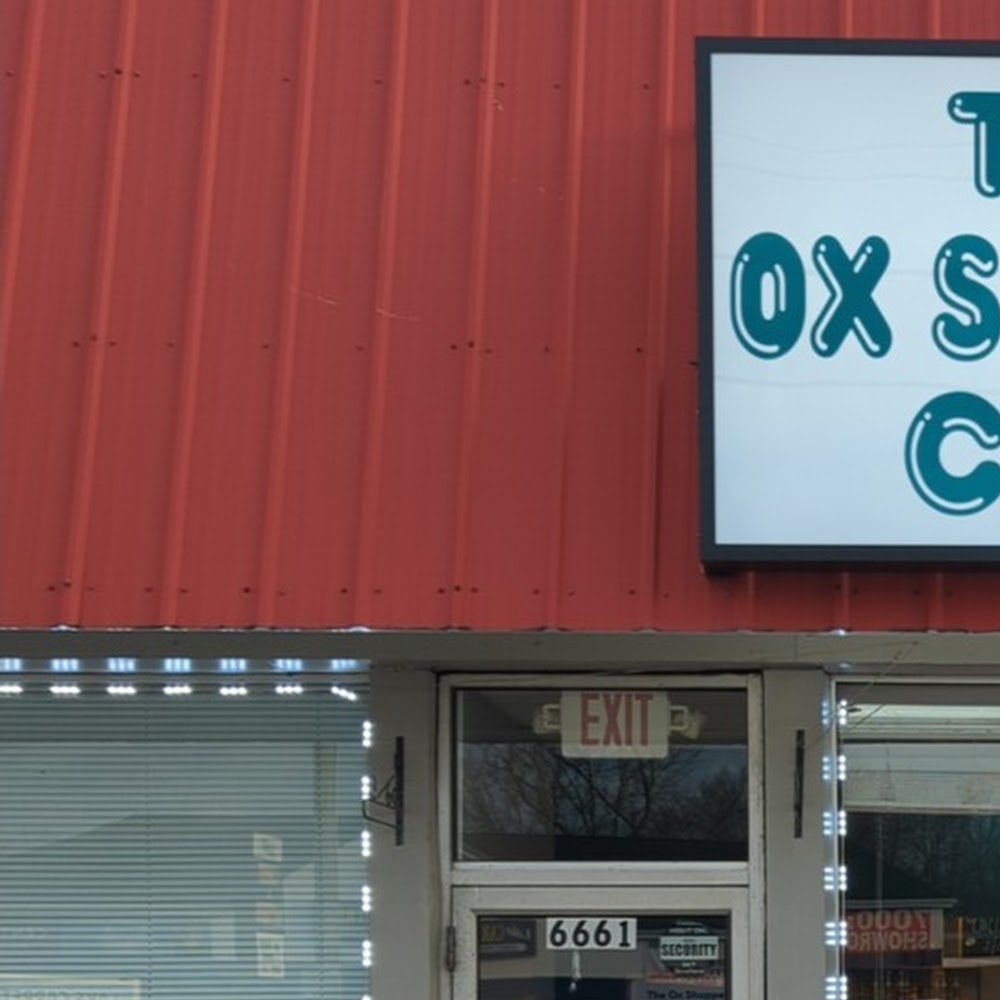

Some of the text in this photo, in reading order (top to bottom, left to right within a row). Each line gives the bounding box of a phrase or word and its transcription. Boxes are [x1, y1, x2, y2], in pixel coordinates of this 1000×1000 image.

[730, 231, 893, 360] OX
[579, 692, 653, 747] EXIT
[549, 919, 631, 947] 6661
[662, 943, 717, 957] SECURITY
